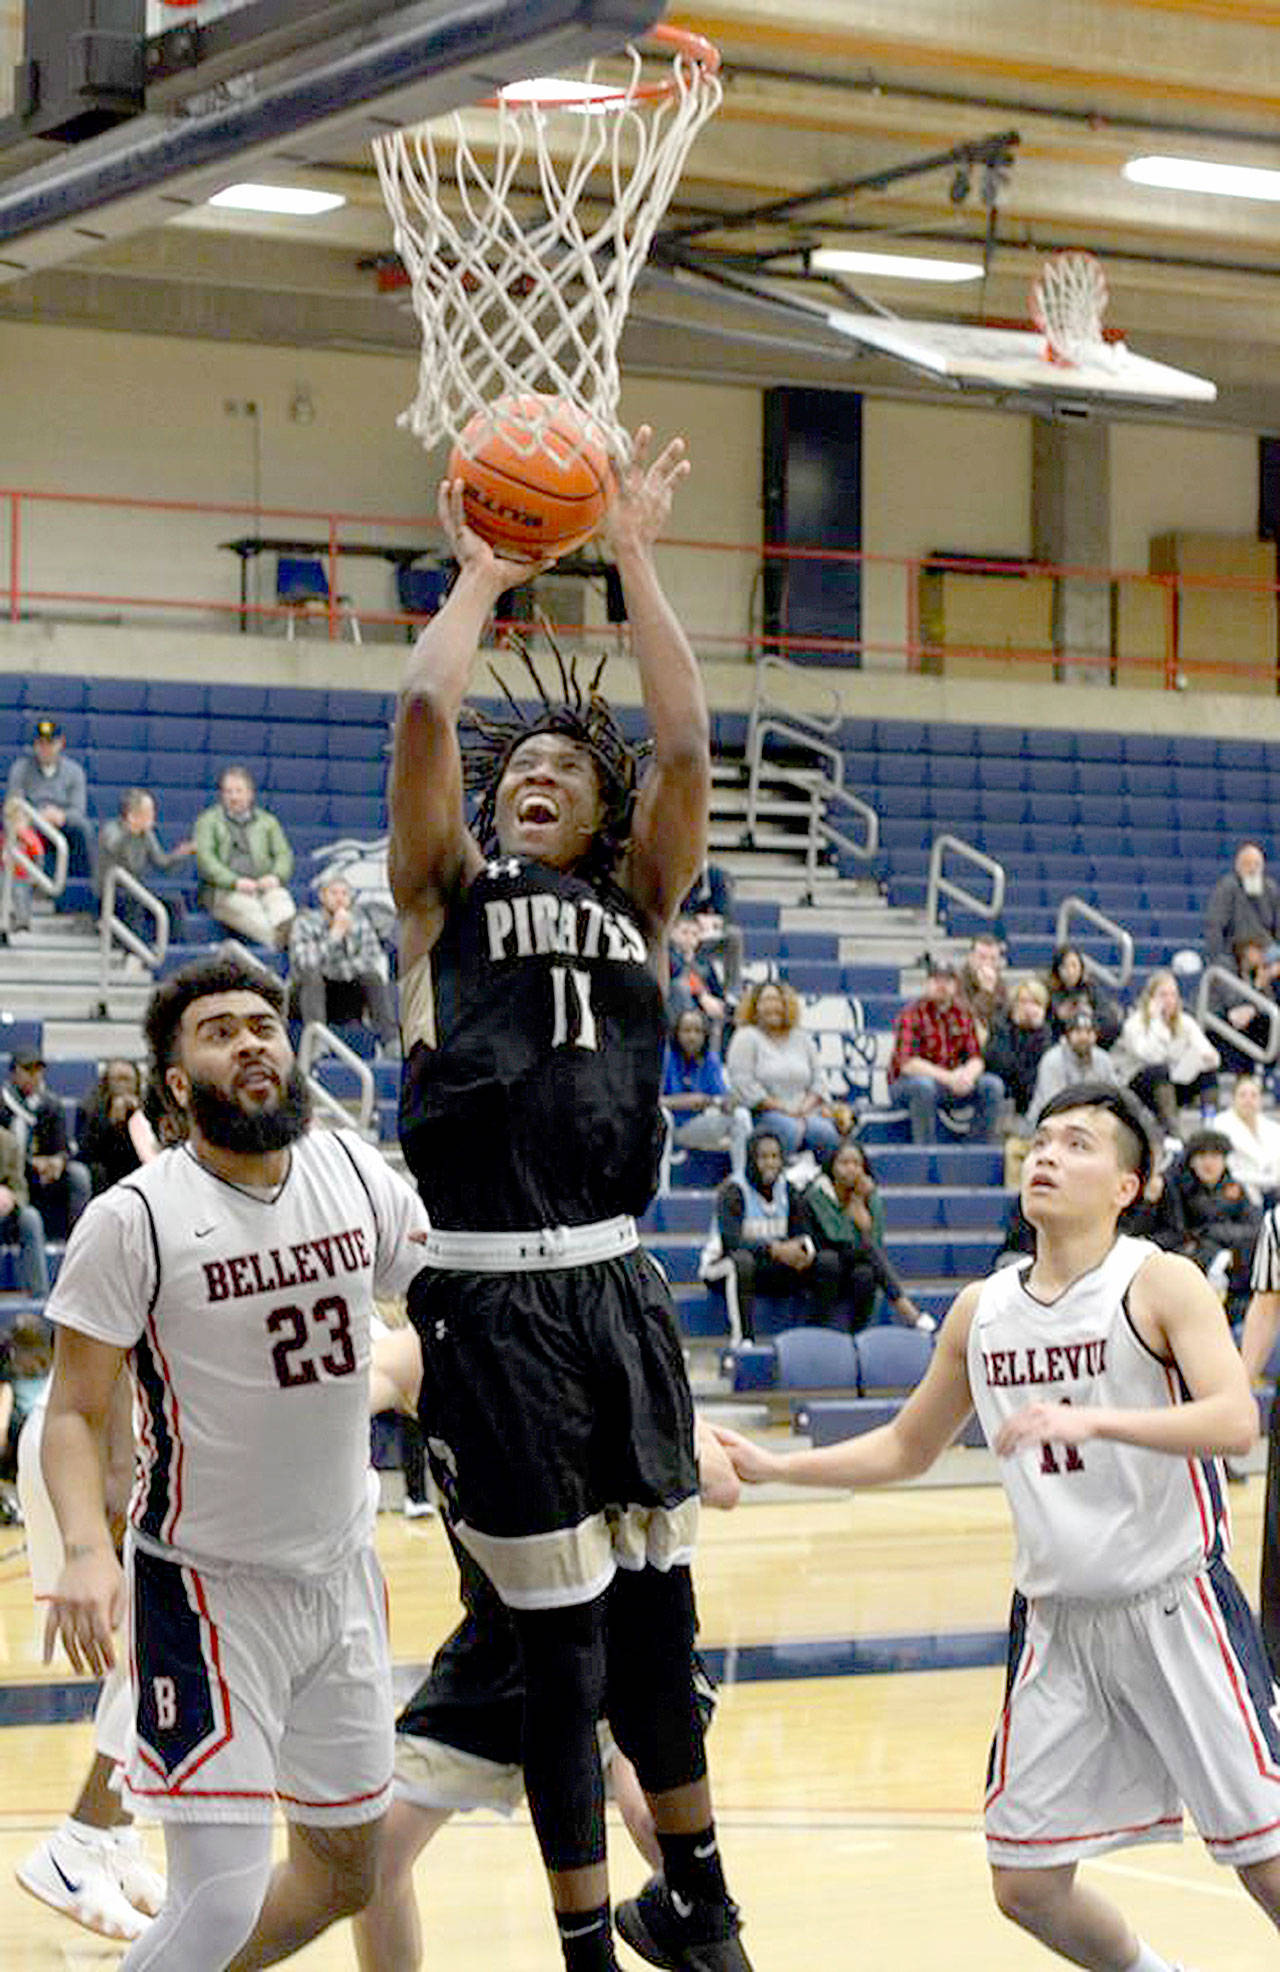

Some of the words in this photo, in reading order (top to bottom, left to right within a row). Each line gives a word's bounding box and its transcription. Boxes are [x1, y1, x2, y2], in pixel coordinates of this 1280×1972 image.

[484, 894, 647, 962] PIRATES
[551, 967, 598, 1050] 11
[203, 1228, 370, 1302] BELLEVUE
[266, 1296, 355, 1388] 23
[982, 1339, 1106, 1386] ELLEVU
[153, 1676, 176, 1731] B
